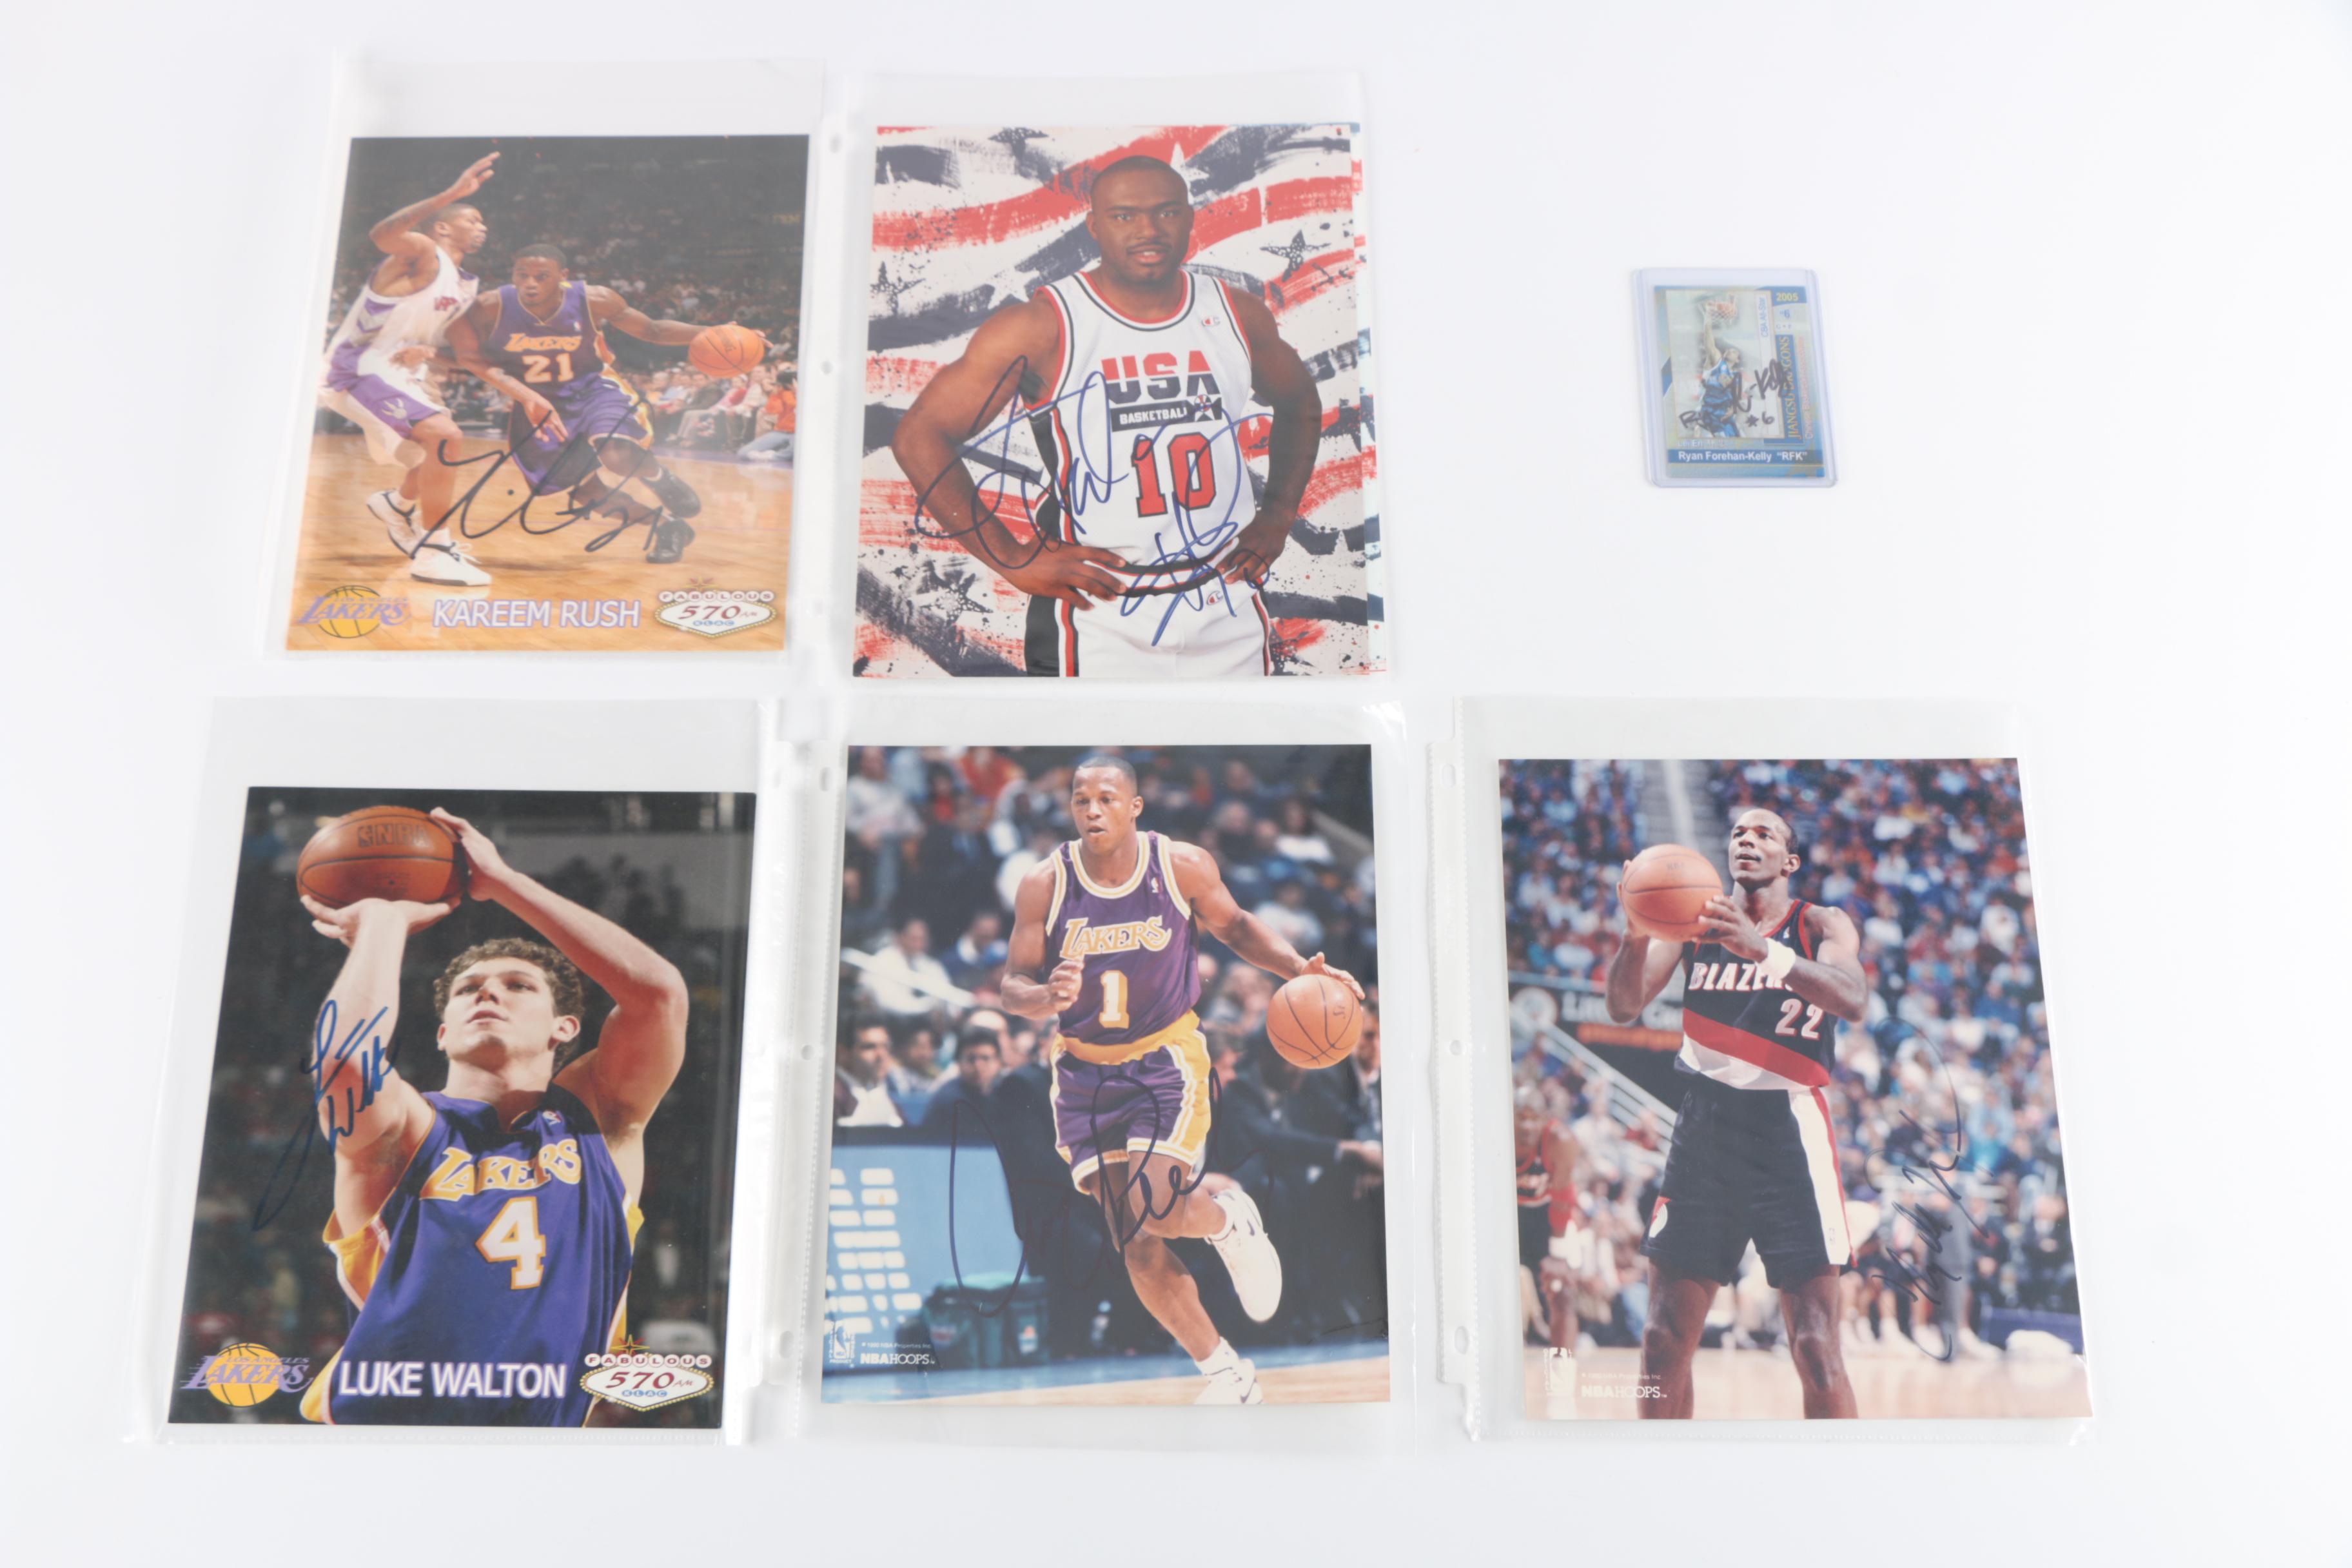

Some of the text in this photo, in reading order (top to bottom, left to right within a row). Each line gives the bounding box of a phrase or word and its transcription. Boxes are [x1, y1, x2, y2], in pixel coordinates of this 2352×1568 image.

[1776, 292, 1799, 302] 2005
[522, 353, 574, 383] 21
[1101, 350, 1220, 404] USA
[1678, 451, 1703, 462] Ryan
[1705, 451, 1772, 463] Forehan-Kelly
[1131, 431, 1217, 518] 10
[295, 596, 411, 625] LAKERS
[433, 600, 642, 627] KAREEM RUSH
[661, 593, 772, 601] FABULOUS
[678, 605, 741, 620] 570
[1059, 915, 1172, 961] LAKERS
[1099, 970, 1130, 1029] 1
[1775, 998, 1825, 1041] 22
[419, 1139, 582, 1202] LAKERS
[475, 1196, 546, 1290] 4
[181, 1355, 314, 1393] LAKERS
[587, 1356, 709, 1366] FABULOUS
[338, 1360, 568, 1398] LUKE WALTON
[605, 1371, 675, 1389] 570
